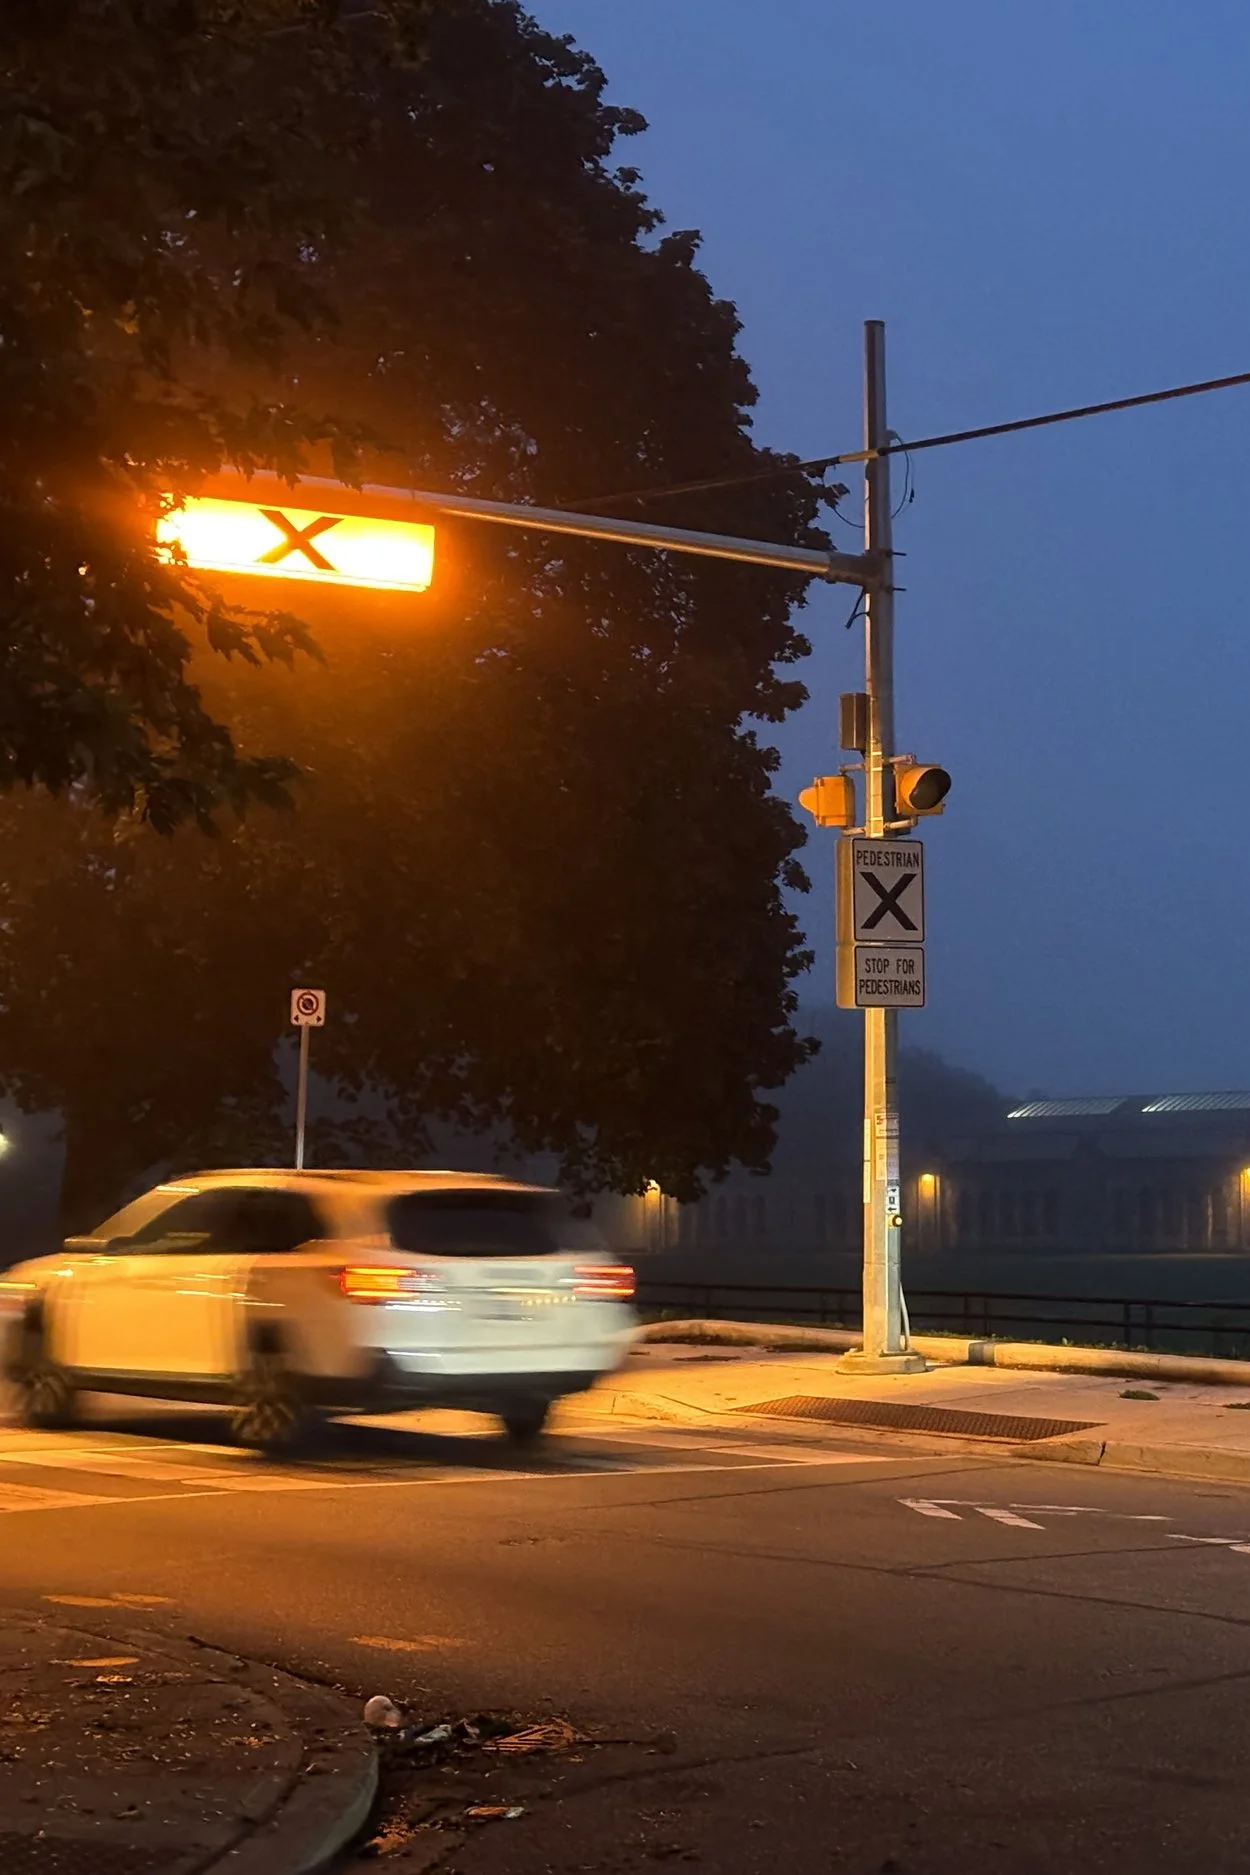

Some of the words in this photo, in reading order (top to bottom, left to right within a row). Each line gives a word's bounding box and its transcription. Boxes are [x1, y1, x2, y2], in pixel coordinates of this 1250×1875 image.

[856, 849, 920, 868] PEDESTRIAN
[864, 958, 890, 974] STOP
[896, 958, 915, 974] FOR
[859, 979, 921, 995] PEDESTRIANS
